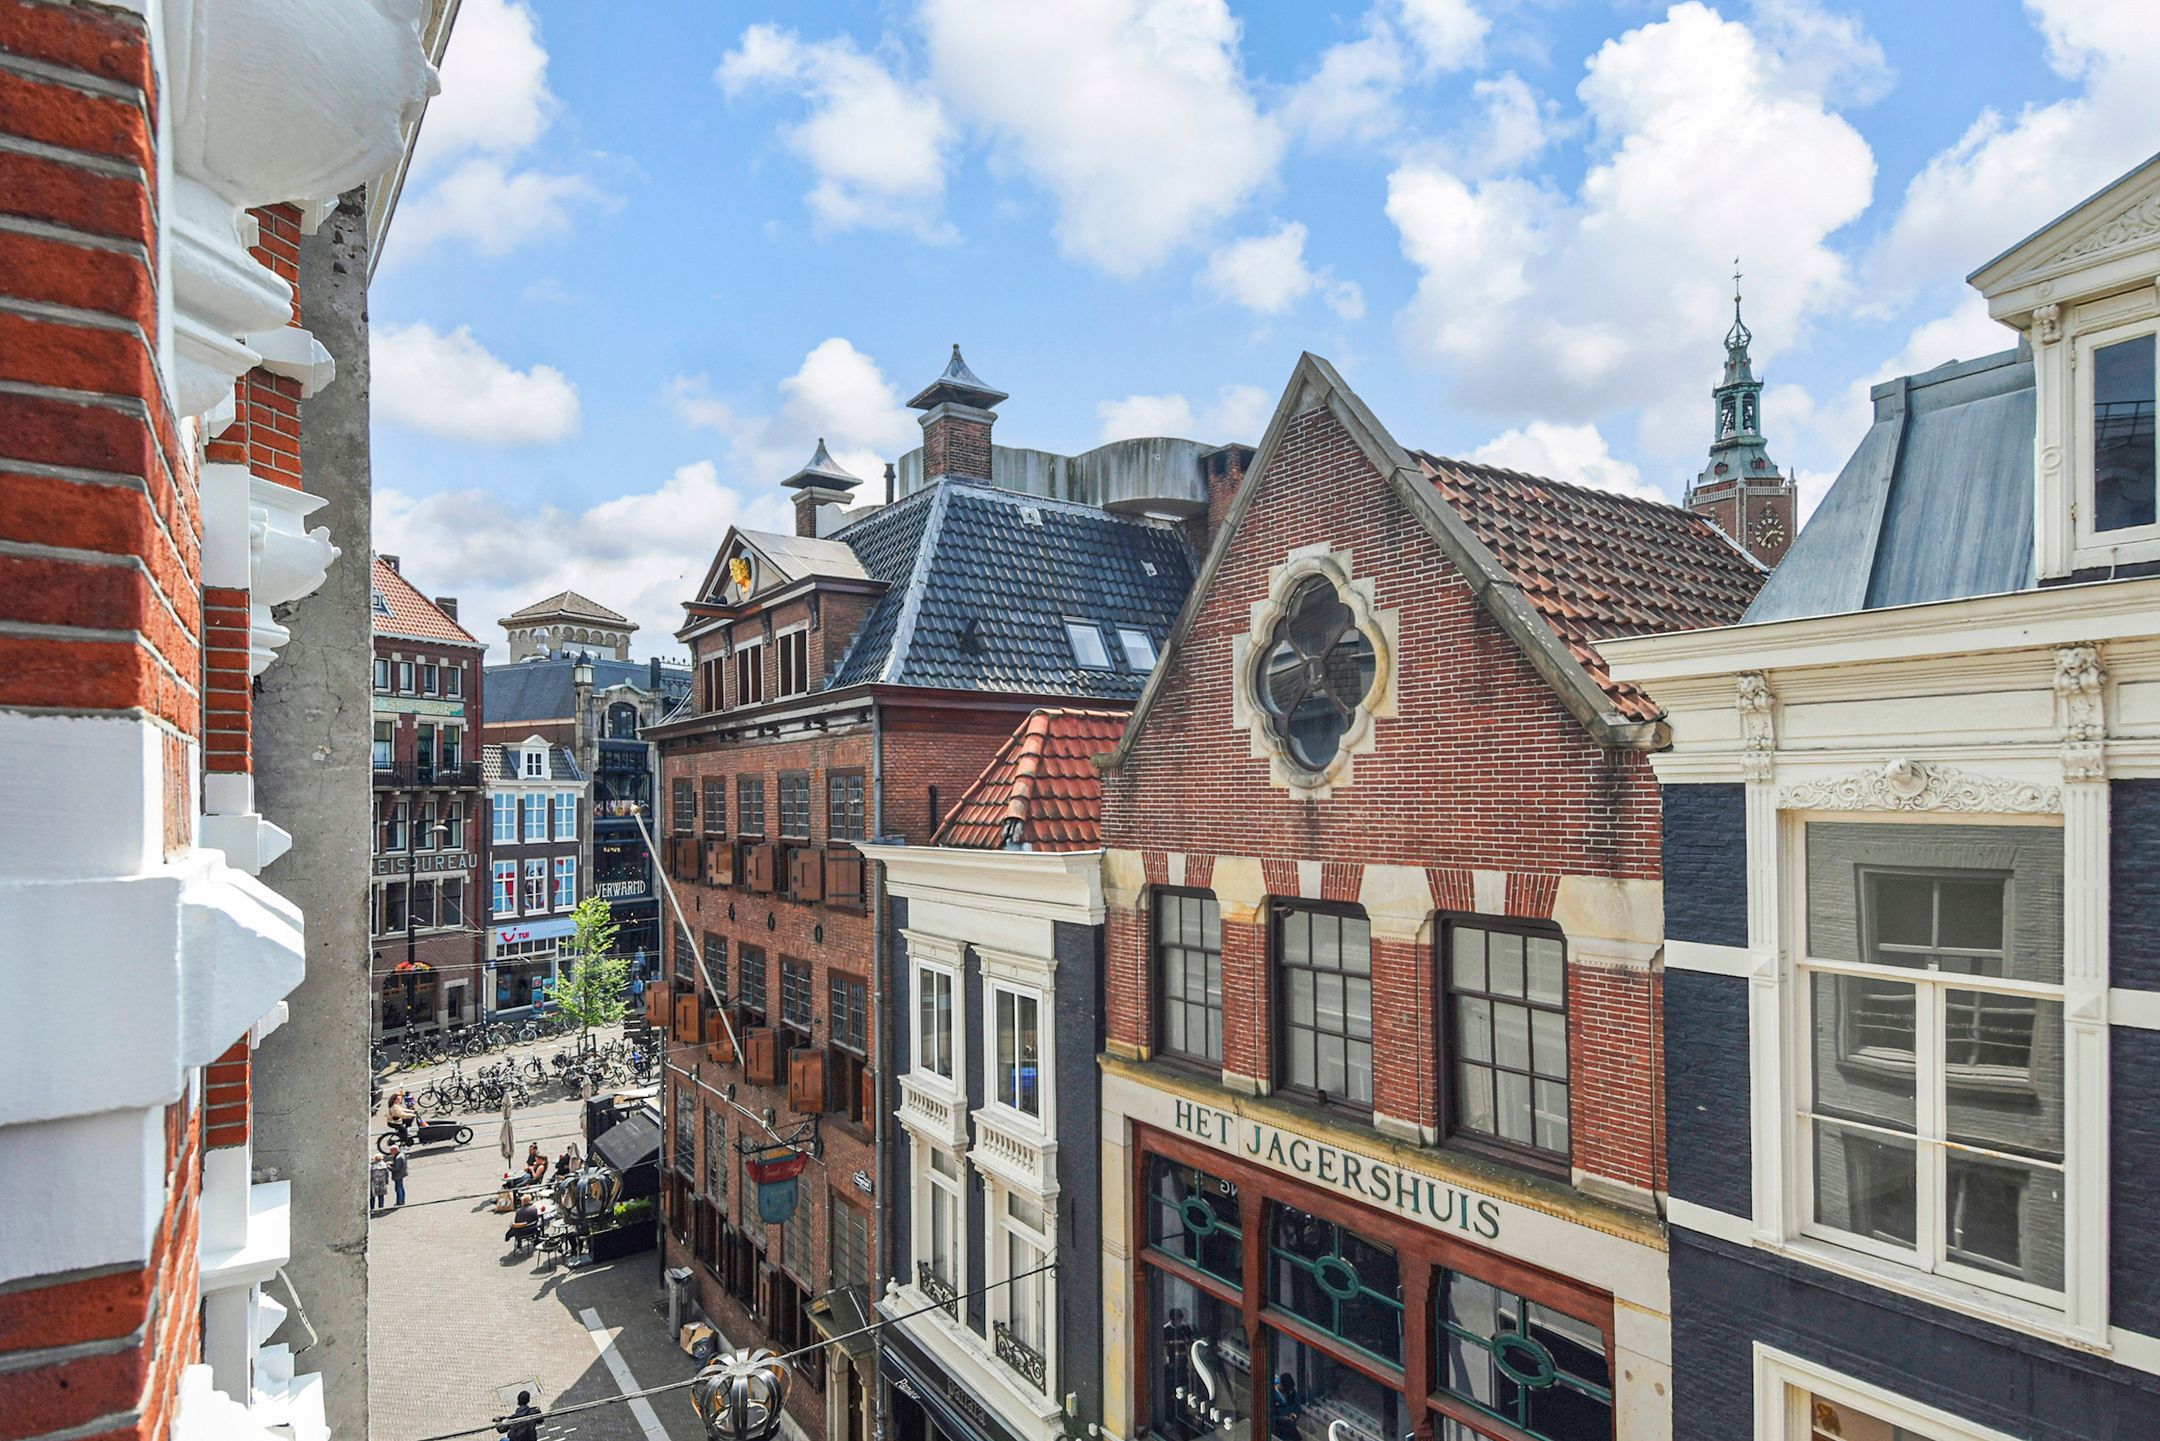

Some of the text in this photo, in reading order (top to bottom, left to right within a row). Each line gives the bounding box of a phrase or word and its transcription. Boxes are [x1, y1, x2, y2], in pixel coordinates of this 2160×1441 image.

[595, 880, 646, 898] VERWARMD
[518, 931, 530, 939] TUI
[1175, 1099, 1500, 1239] HET JAGERSHUIS
[1175, 1386, 1233, 1431] SKINS
